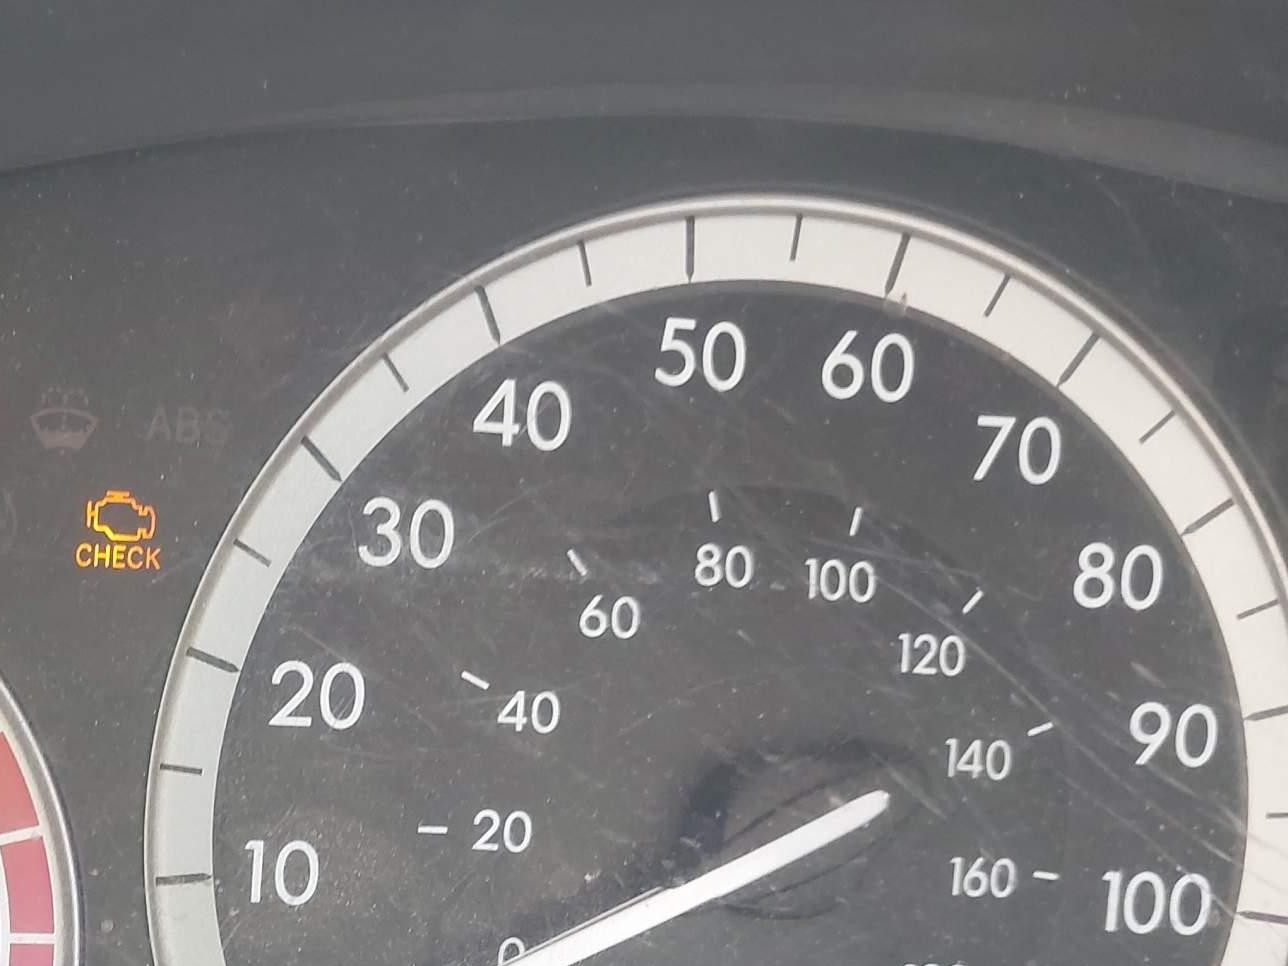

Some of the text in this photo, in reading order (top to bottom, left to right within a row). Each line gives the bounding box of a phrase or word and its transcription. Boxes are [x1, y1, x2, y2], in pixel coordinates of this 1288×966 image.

[654, 317, 746, 392] 50
[821, 330, 915, 403] 60
[147, 406, 232, 446] ABS
[473, 378, 573, 451] 40
[973, 415, 1062, 485] 70
[75, 544, 161, 570] CHECK
[357, 497, 455, 569] 30
[694, 544, 753, 588] 80
[804, 558, 877, 603] 100
[1073, 542, 1164, 611] 80
[579, 595, 641, 640] 60
[897, 633, 966, 677] 120
[268, 660, 366, 730] 20
[497, 691, 561, 734] 40
[945, 738, 1012, 781] 140
[1129, 702, 1219, 768] 90
[472, 809, 533, 853] 20
[245, 839, 320, 906] 10
[949, 857, 1018, 899] 160
[1103, 871, 1213, 936] 100
